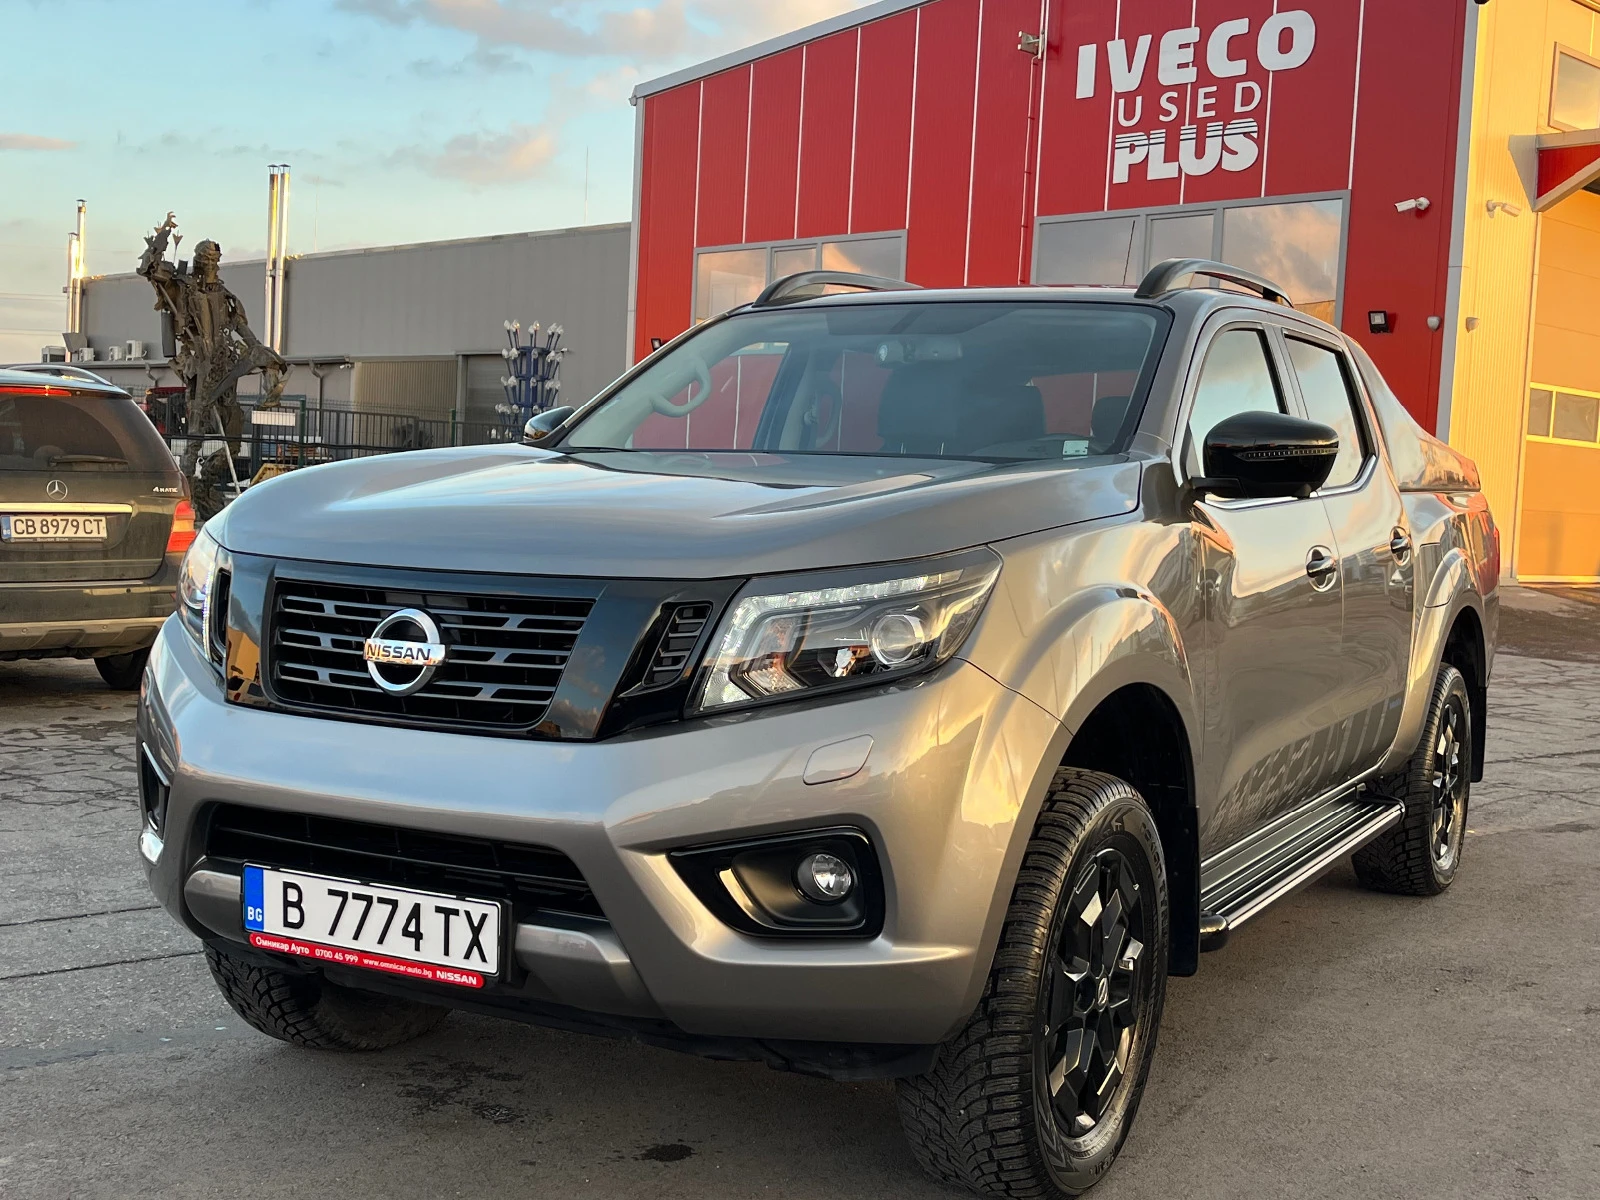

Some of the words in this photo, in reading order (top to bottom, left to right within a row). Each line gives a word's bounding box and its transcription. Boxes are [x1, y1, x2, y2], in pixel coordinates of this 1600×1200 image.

[1076, 9, 1316, 99] IVECO
[1117, 81, 1262, 127] USED
[1112, 117, 1260, 184] PLUS
[13, 518, 37, 536] CB
[40, 518, 80, 536] 8979
[83, 518, 103, 536] CT
[367, 644, 431, 660] NISSAN
[246, 906, 263, 923] BG
[282, 881, 305, 930] B
[255, 936, 290, 951] Омникар
[290, 943, 310, 955] Ауто
[315, 948, 334, 959] 0700
[333, 952, 344, 961] 45
[344, 954, 359, 964] 999
[363, 958, 432, 977] www.omnicar-auto.bg
[436, 970, 477, 985] NISSAN
